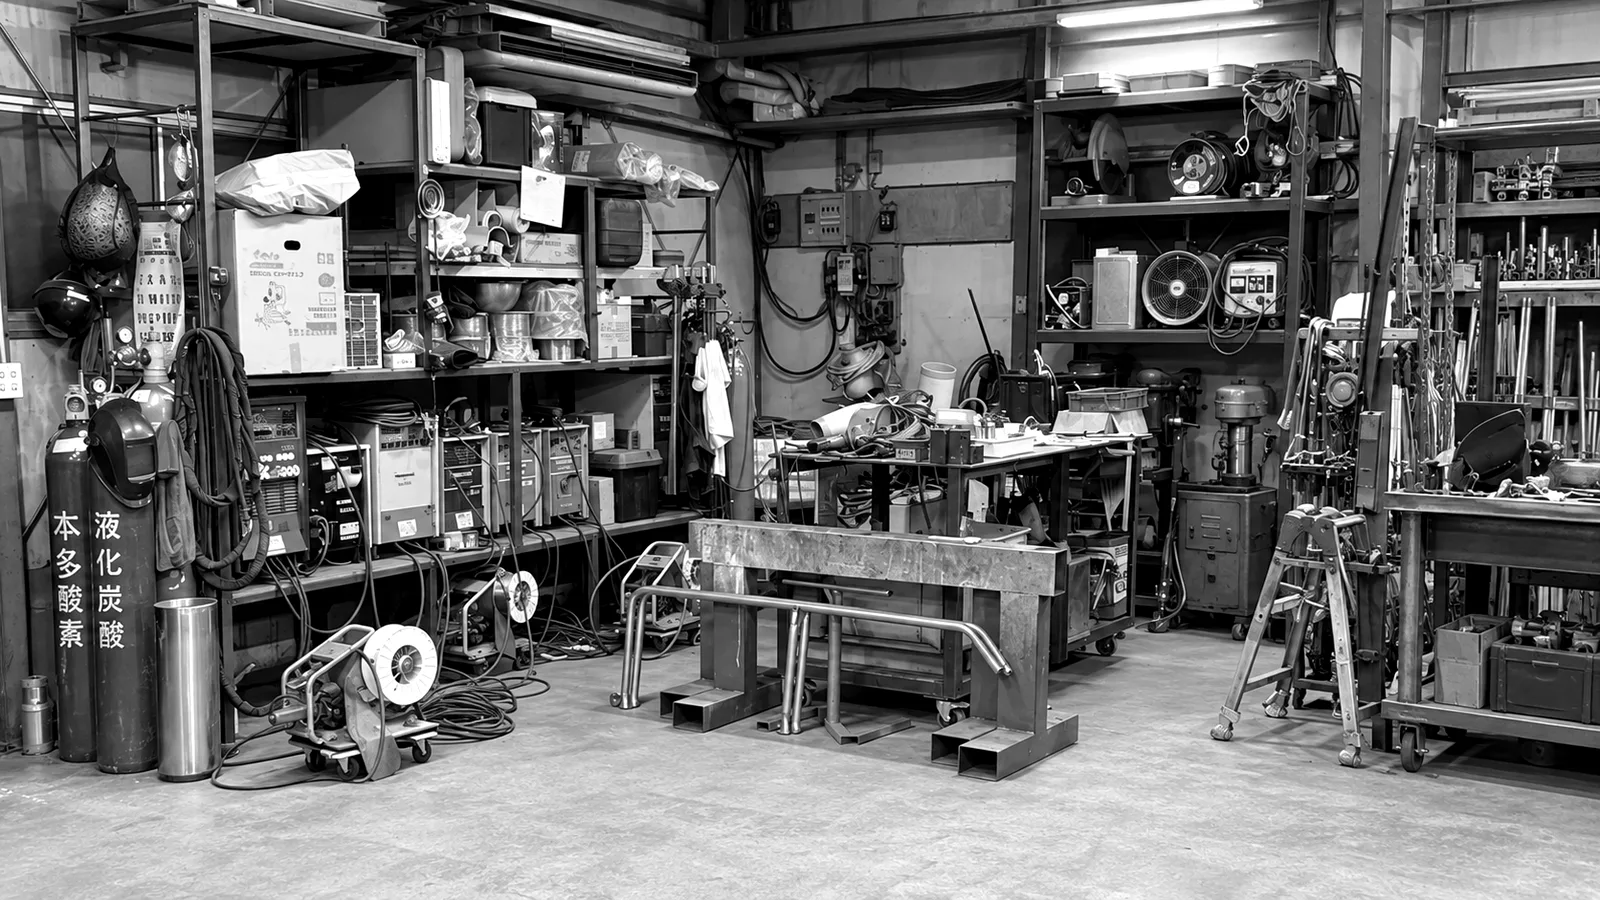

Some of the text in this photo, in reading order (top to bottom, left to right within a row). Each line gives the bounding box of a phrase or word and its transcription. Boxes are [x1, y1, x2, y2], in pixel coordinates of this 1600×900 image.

[53, 510, 84, 649] 本多酸素
[94, 510, 125, 649] 液化炭酸
